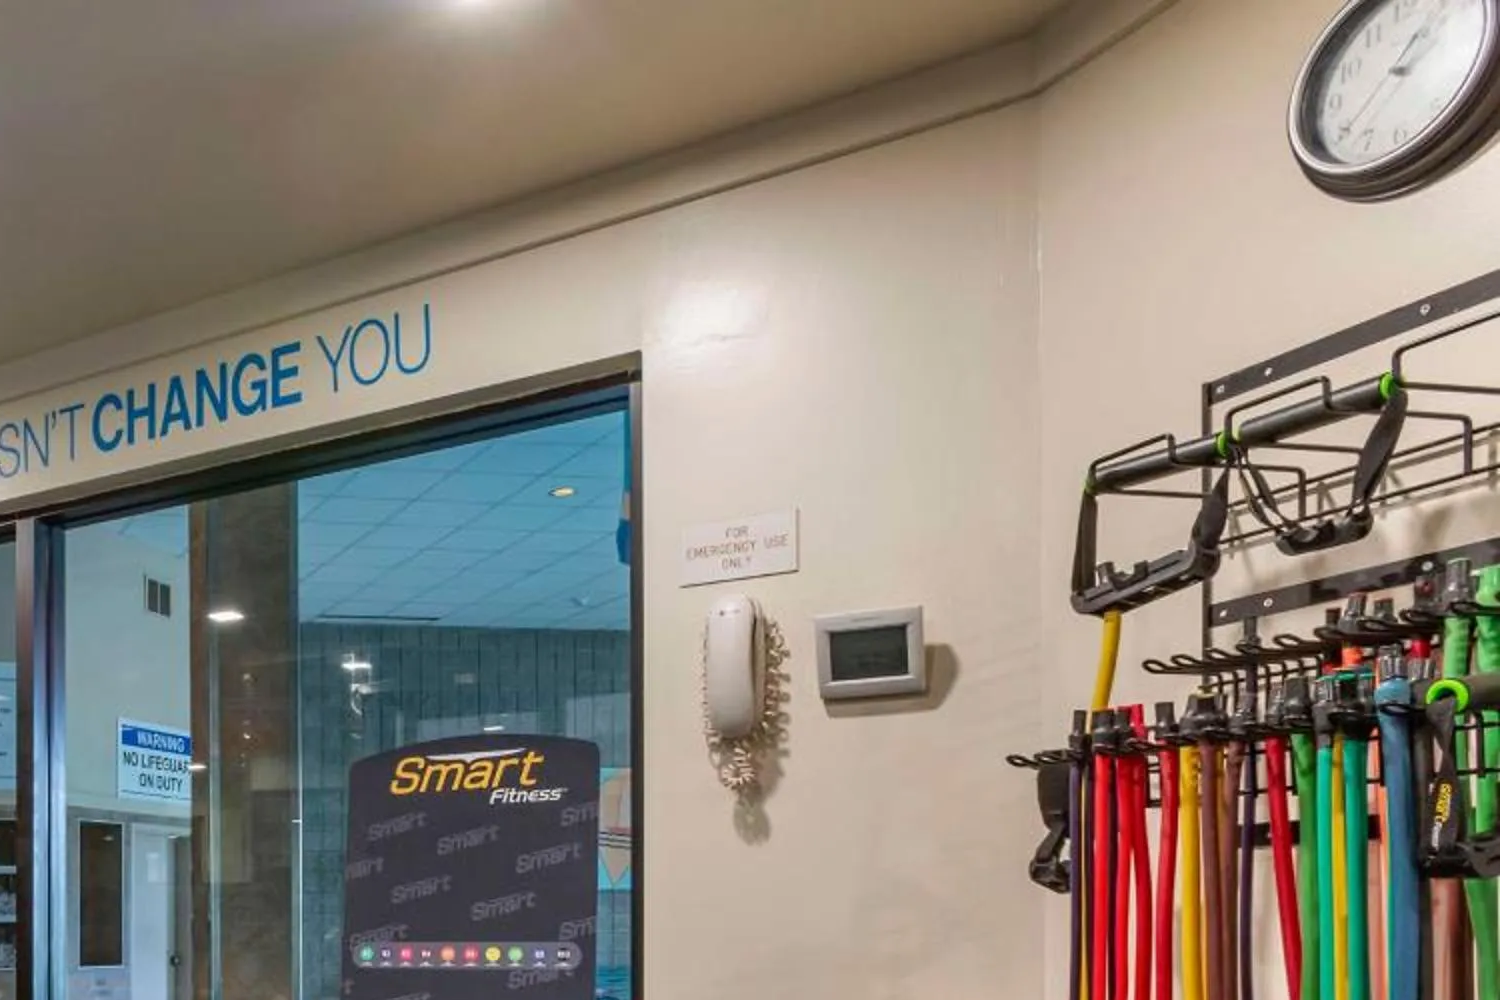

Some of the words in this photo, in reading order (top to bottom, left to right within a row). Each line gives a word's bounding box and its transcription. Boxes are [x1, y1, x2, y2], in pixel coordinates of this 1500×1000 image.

[91, 340, 303, 453] CHANGE
[316, 303, 431, 393] YOU
[725, 525, 749, 540] FOR
[685, 540, 757, 562] EMERGENCY
[763, 533, 790, 550] USE
[721, 556, 753, 572] ONLY
[136, 730, 186, 753] WARNING
[122, 751, 139, 767] NO
[389, 749, 545, 796] Smart
[139, 773, 155, 789] ON
[157, 775, 184, 792] DUTY
[489, 787, 563, 806] Fitness
[367, 811, 428, 842] Smart
[437, 825, 500, 856] Smart
[515, 842, 583, 875] Smart
[390, 874, 453, 904] Smart
[470, 892, 537, 921] Smart
